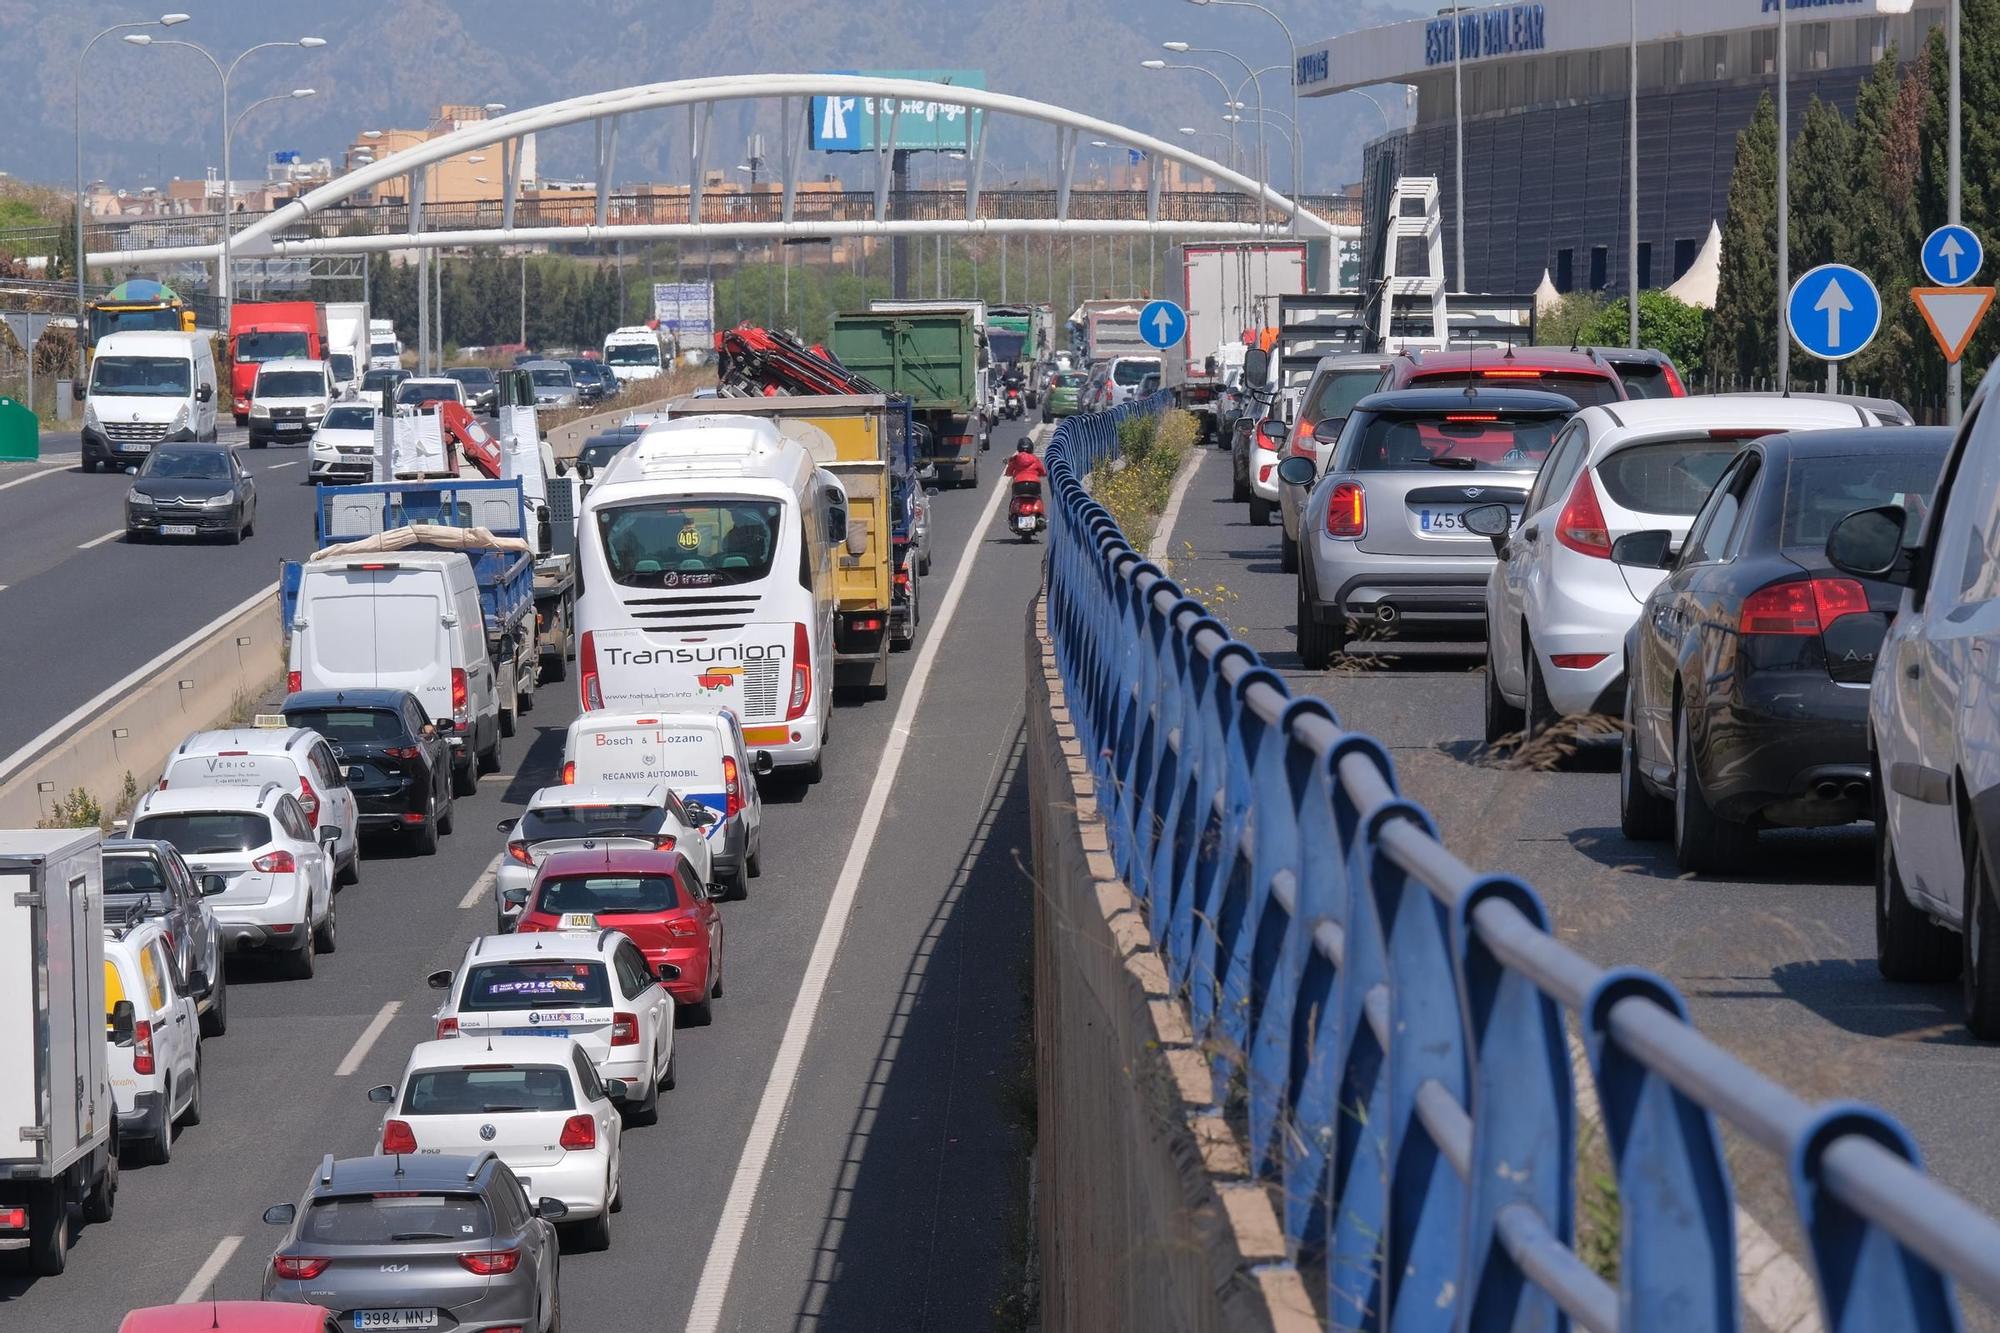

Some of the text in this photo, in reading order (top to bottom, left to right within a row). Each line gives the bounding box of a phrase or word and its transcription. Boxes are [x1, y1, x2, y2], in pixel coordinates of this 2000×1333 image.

[1482, 5, 1544, 55] BALEAR
[679, 531, 698, 545] 405
[603, 643, 786, 665] Transunion
[604, 692, 692, 700] www.transunion.info
[595, 733, 633, 746] Bosch
[656, 731, 703, 744] Lozano
[206, 759, 256, 773] VERICO
[602, 769, 699, 781] RECANVIS AUTOMOBIL
[572, 915, 591, 926] TAXI
[514, 981, 535, 989] 971
[542, 1014, 559, 1022] TAXI
[380, 1264, 409, 1273] KIA
[363, 1310, 434, 1326] 3984 MNJ
